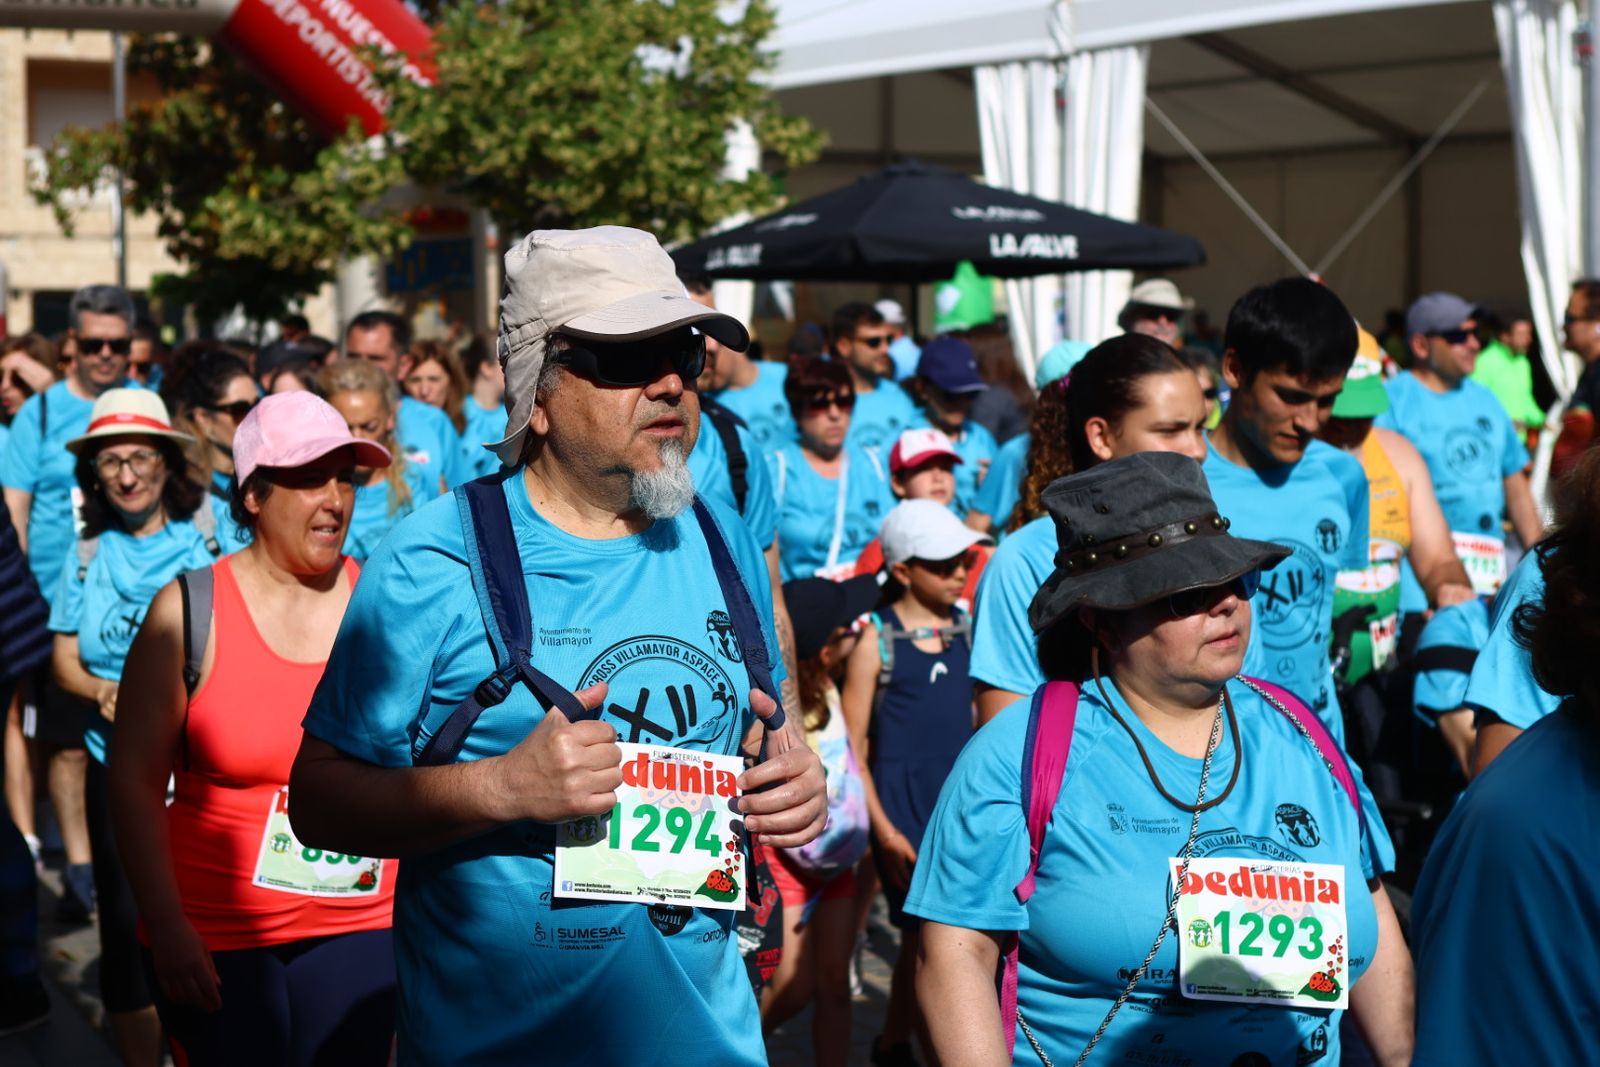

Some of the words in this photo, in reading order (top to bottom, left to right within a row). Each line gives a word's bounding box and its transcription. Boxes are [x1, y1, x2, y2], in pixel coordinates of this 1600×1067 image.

[540, 627, 582, 635] Ayuntamiento
[540, 636, 592, 647] Villamayor
[613, 643, 680, 664] VILLAMAYOR
[682, 651, 720, 683] ASPACE
[609, 802, 722, 858] 1294
[1132, 825, 1181, 835] Villamayor
[1176, 865, 1339, 904] bedunia
[557, 926, 626, 939] SUMESAL
[1213, 911, 1324, 960] 1293
